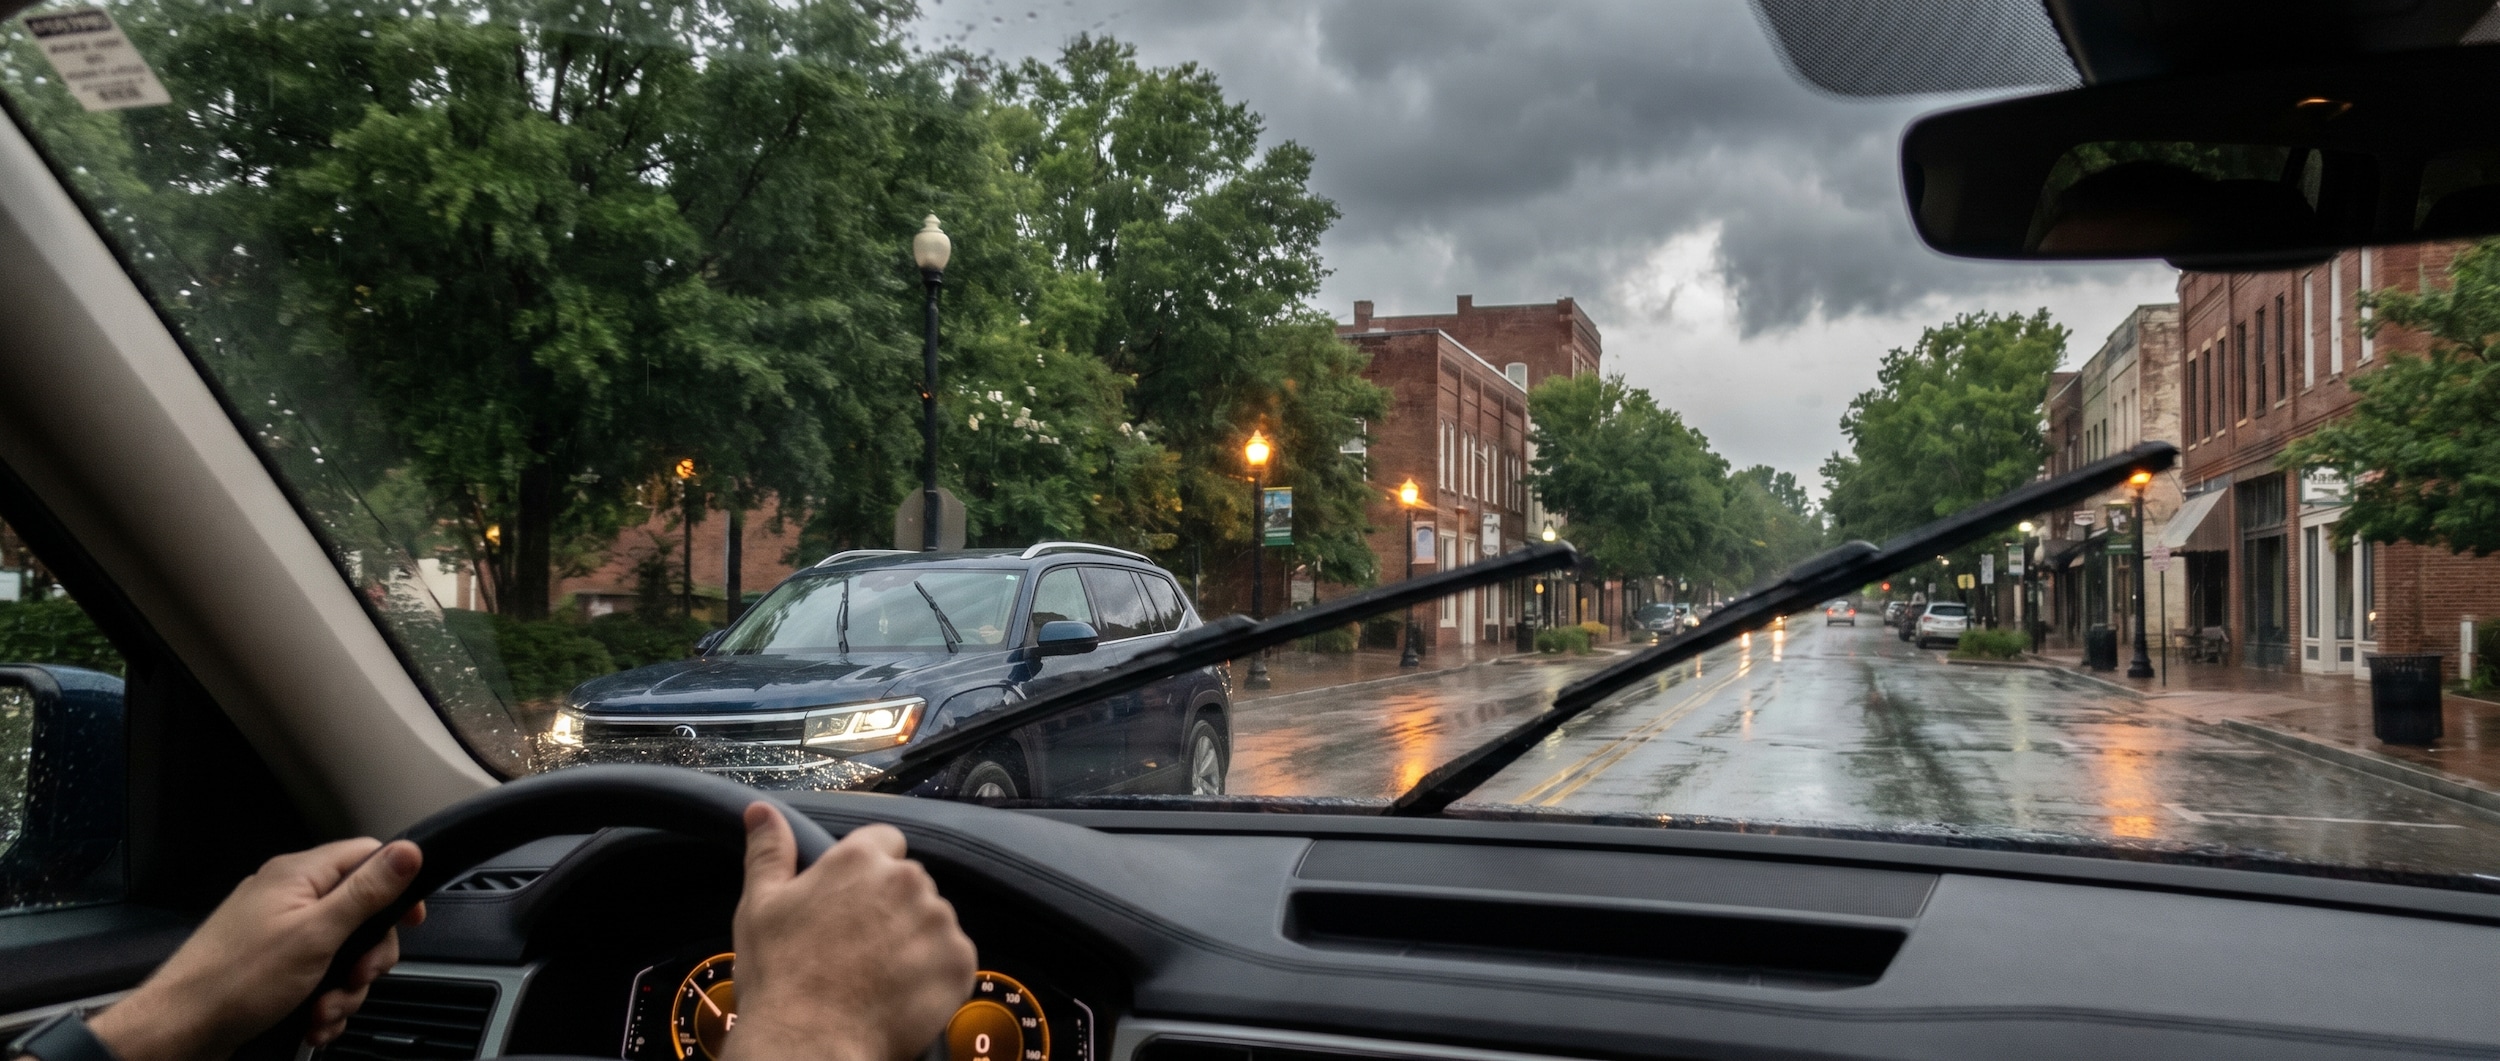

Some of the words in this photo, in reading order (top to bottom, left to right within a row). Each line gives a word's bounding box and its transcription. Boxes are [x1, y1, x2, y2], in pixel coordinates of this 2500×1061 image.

[707, 968, 715, 980] 2
[680, 1016, 685, 1026] 1
[975, 1033, 990, 1054] 0
[686, 1046, 694, 1057] 0
